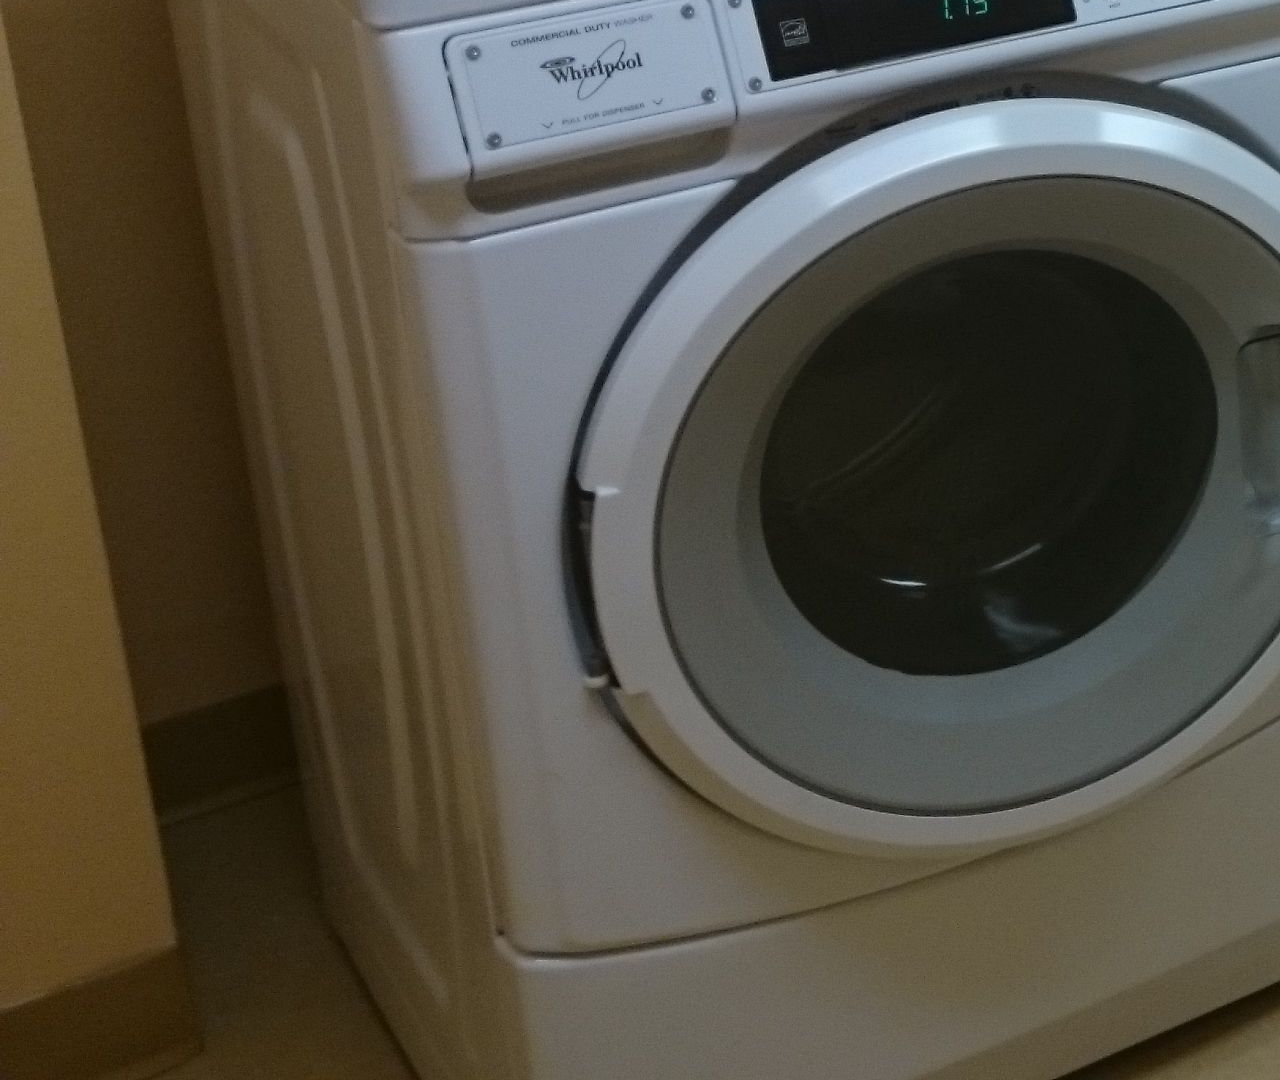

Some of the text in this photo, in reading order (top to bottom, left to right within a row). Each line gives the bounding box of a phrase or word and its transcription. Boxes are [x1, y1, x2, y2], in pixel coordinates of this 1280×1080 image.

[510, 27, 582, 48] COMMERCIAL
[584, 21, 611, 33] DUTY
[549, 51, 645, 84] Whirlpool
